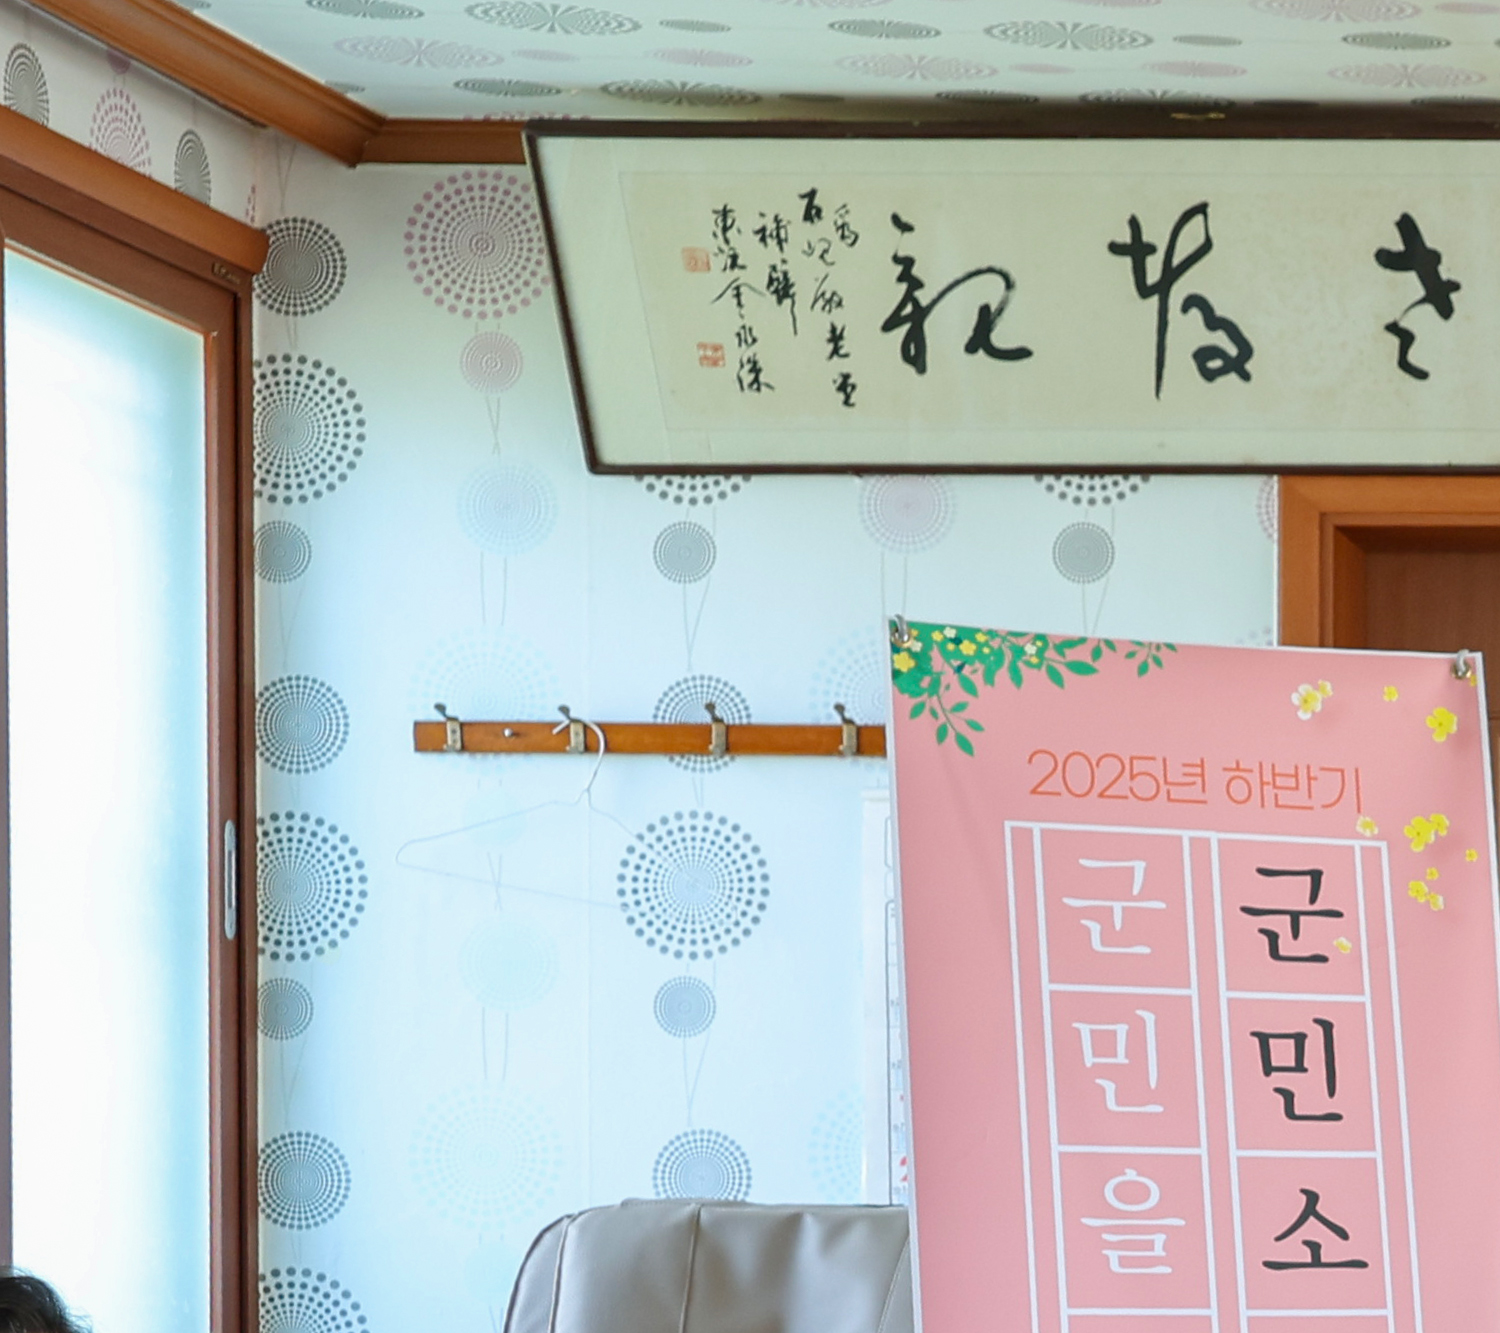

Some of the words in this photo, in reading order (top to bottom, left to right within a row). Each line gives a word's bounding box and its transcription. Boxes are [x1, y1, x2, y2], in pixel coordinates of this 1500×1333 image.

[1027, 749, 1208, 806] 2025년
[1222, 757, 1363, 815] 하반기
[1061, 857, 1188, 1277] 군민을
